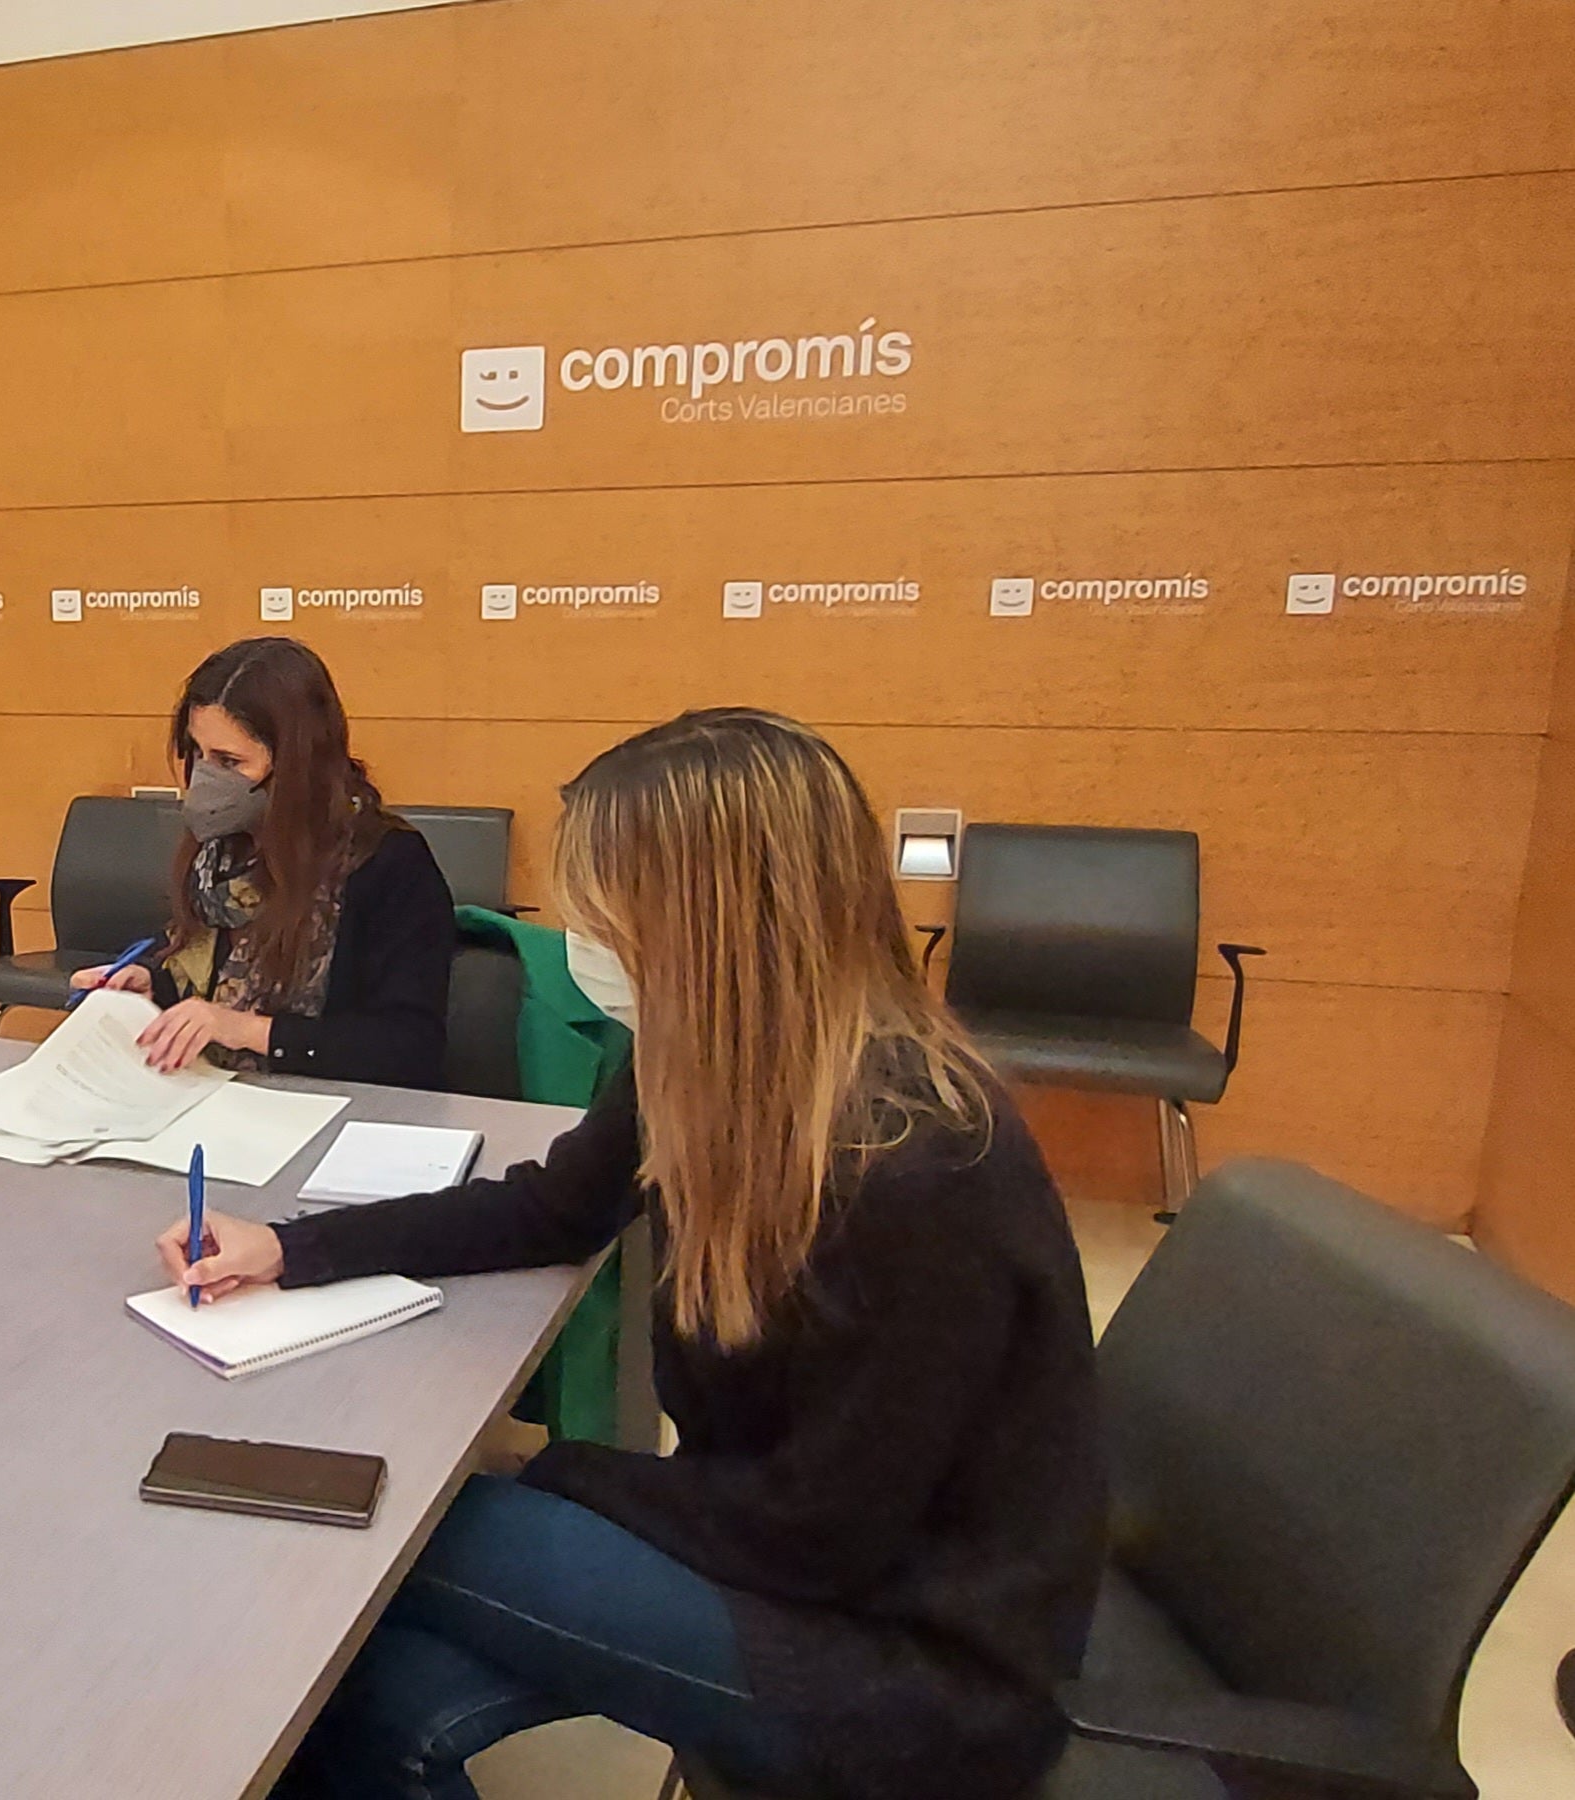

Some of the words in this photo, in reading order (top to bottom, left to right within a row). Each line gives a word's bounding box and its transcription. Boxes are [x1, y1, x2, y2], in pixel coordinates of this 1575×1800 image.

[559, 316, 913, 400] compromís
[659, 397, 734, 424] Corts
[739, 391, 907, 421] Valencianes
[85, 585, 201, 612] compromís
[297, 583, 424, 611] compromís
[522, 580, 660, 608] compromís
[767, 576, 921, 607] compromís
[1039, 572, 1210, 605] compromís
[1341, 568, 1527, 602] compromís
